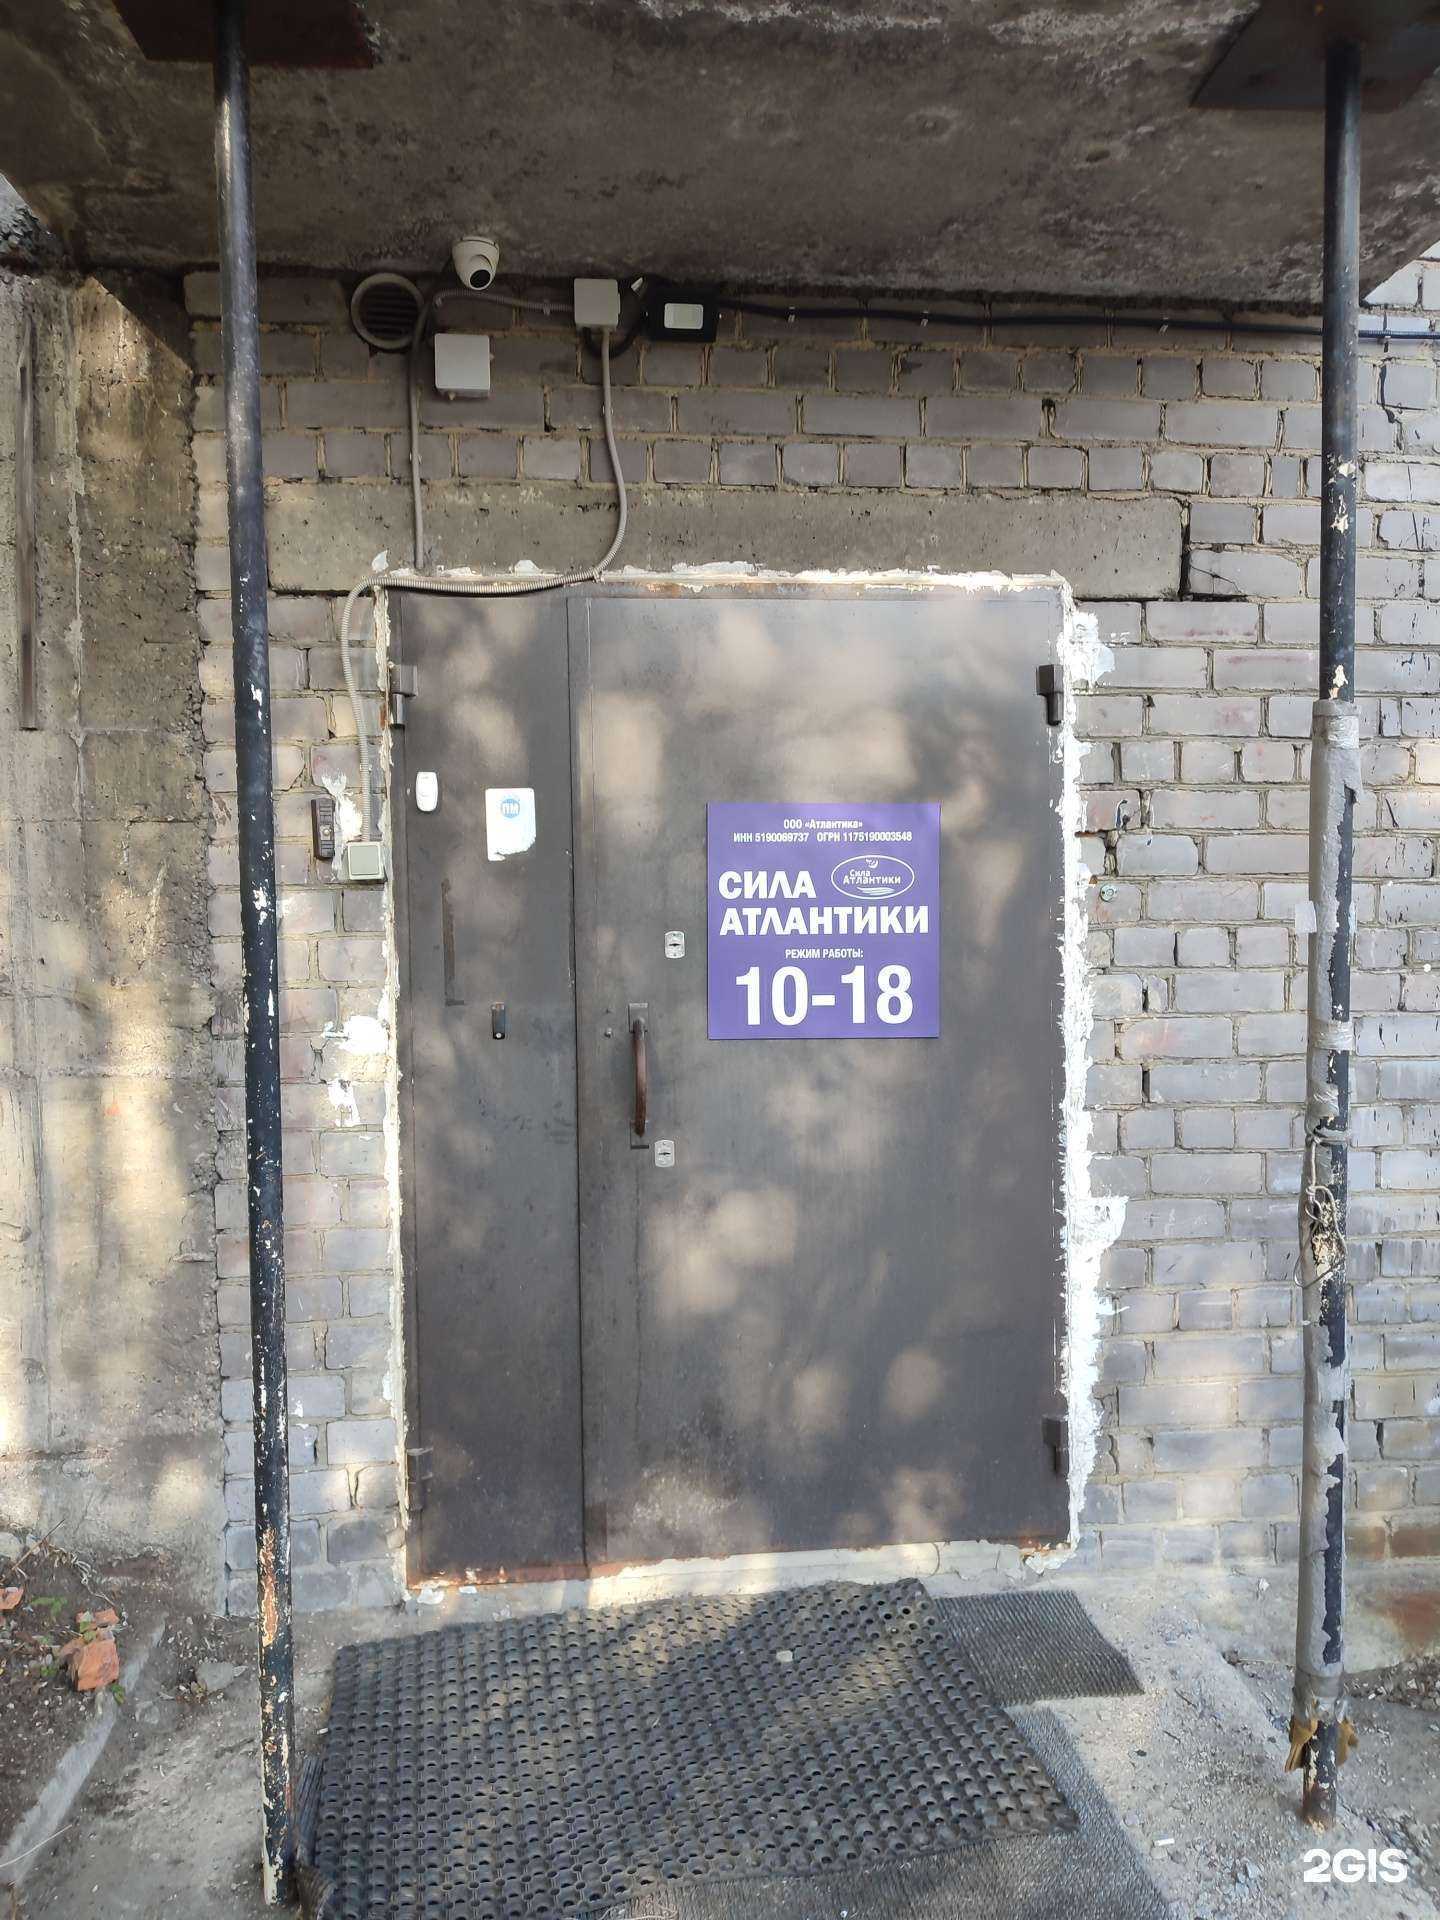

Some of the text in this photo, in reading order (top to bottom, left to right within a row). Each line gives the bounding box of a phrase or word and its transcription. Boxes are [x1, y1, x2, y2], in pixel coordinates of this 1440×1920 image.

[783, 819, 863, 829] ООО «Атлантика»
[733, 832, 753, 842] ИНН
[816, 831, 841, 842] ОГРН
[849, 869, 871, 877] Сила
[718, 870, 817, 899] СИЛА
[843, 875, 901, 885] Атлантики
[719, 905, 929, 936] АТЛАНТИКИ
[785, 948, 864, 959] РЕЖИМ РАБОТЫ:
[735, 964, 914, 1026] 10-18
